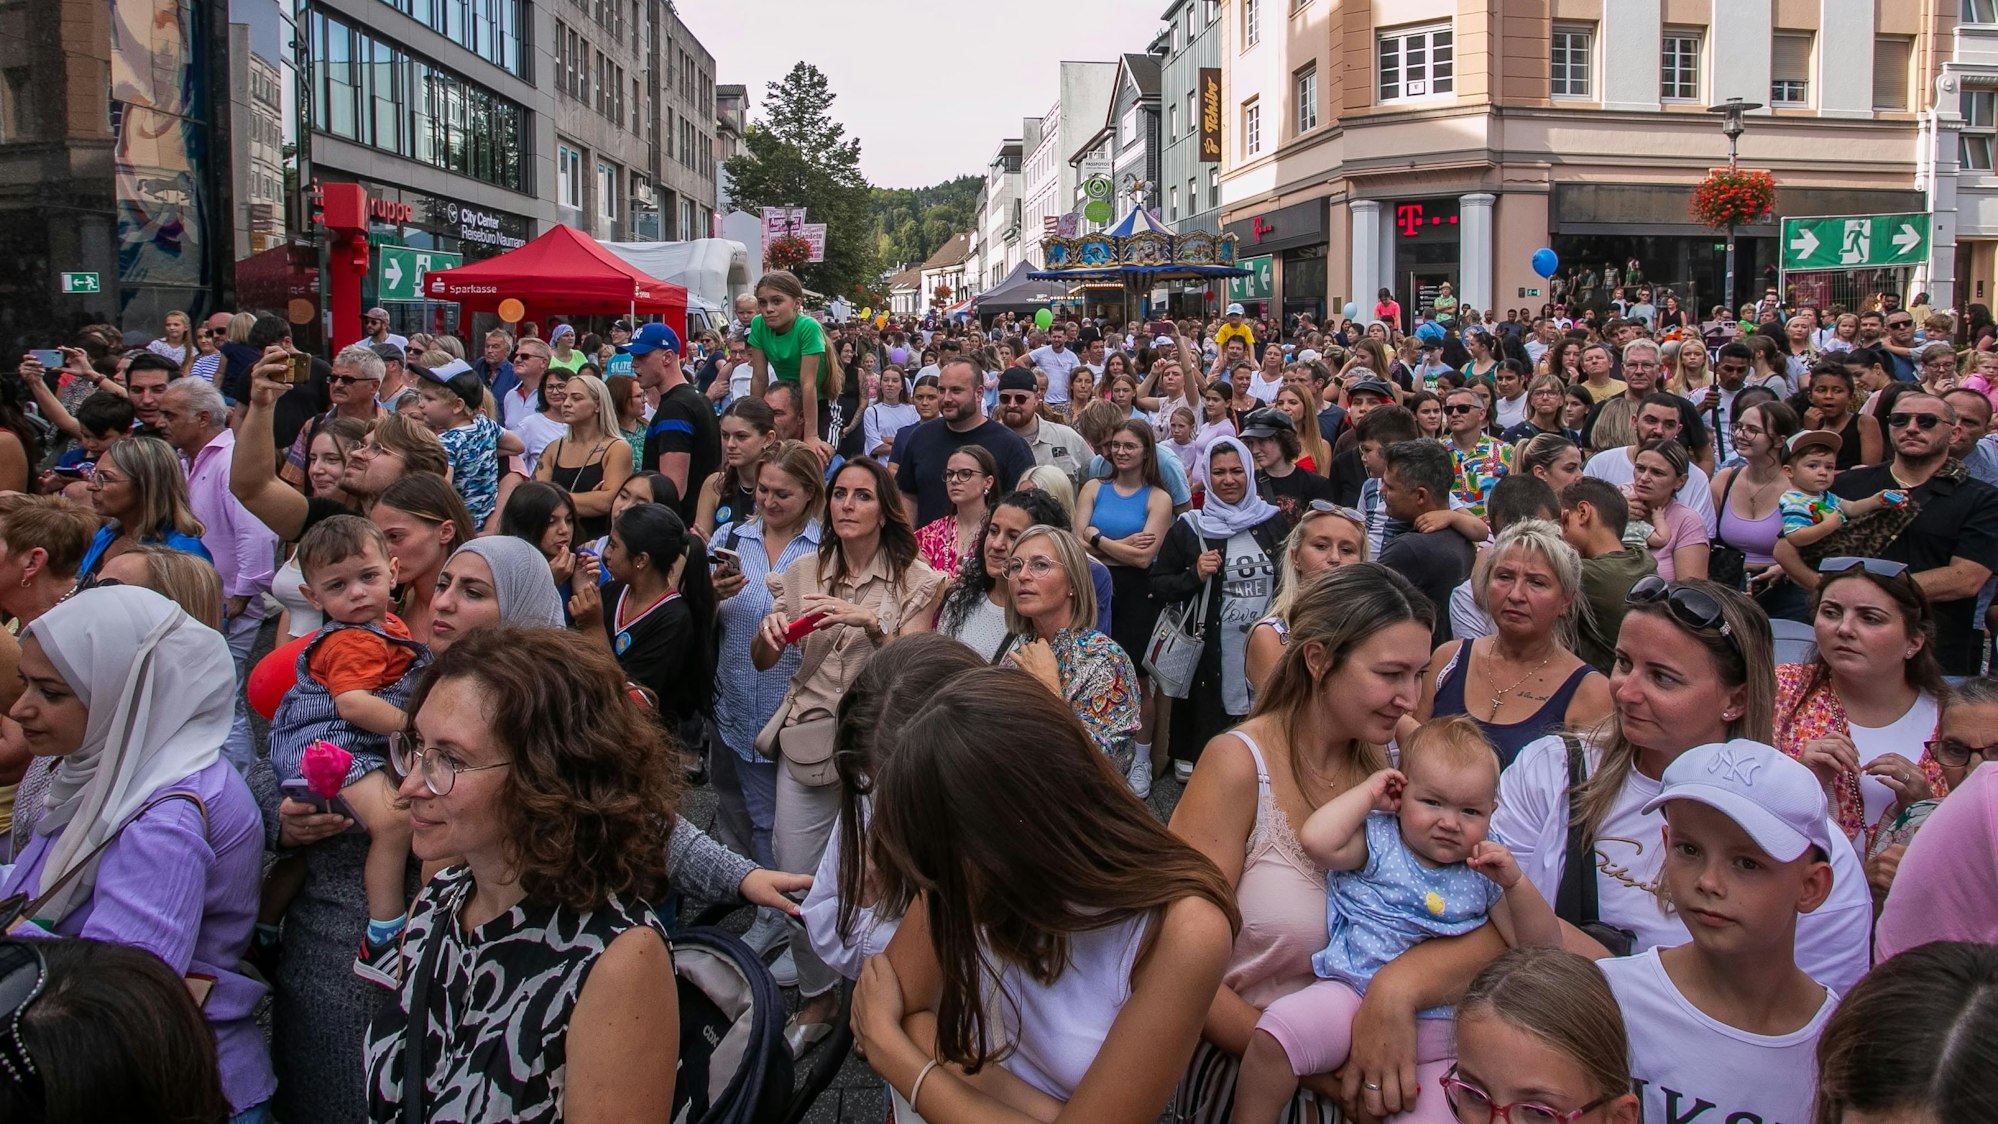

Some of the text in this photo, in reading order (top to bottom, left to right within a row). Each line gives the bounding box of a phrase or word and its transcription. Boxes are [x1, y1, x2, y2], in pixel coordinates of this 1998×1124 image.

[1204, 75, 1219, 133] Tchibo
[370, 197, 414, 227] ruppe
[461, 208, 500, 229] City Center
[1397, 204, 1423, 237] T
[461, 224, 496, 245] Reisebüro
[449, 284, 498, 295] Sparkasse
[610, 361, 632, 373] SKATE
[1225, 553, 1274, 579] OU
[1235, 579, 1263, 597] ARE
[1707, 750, 1761, 787] NY
